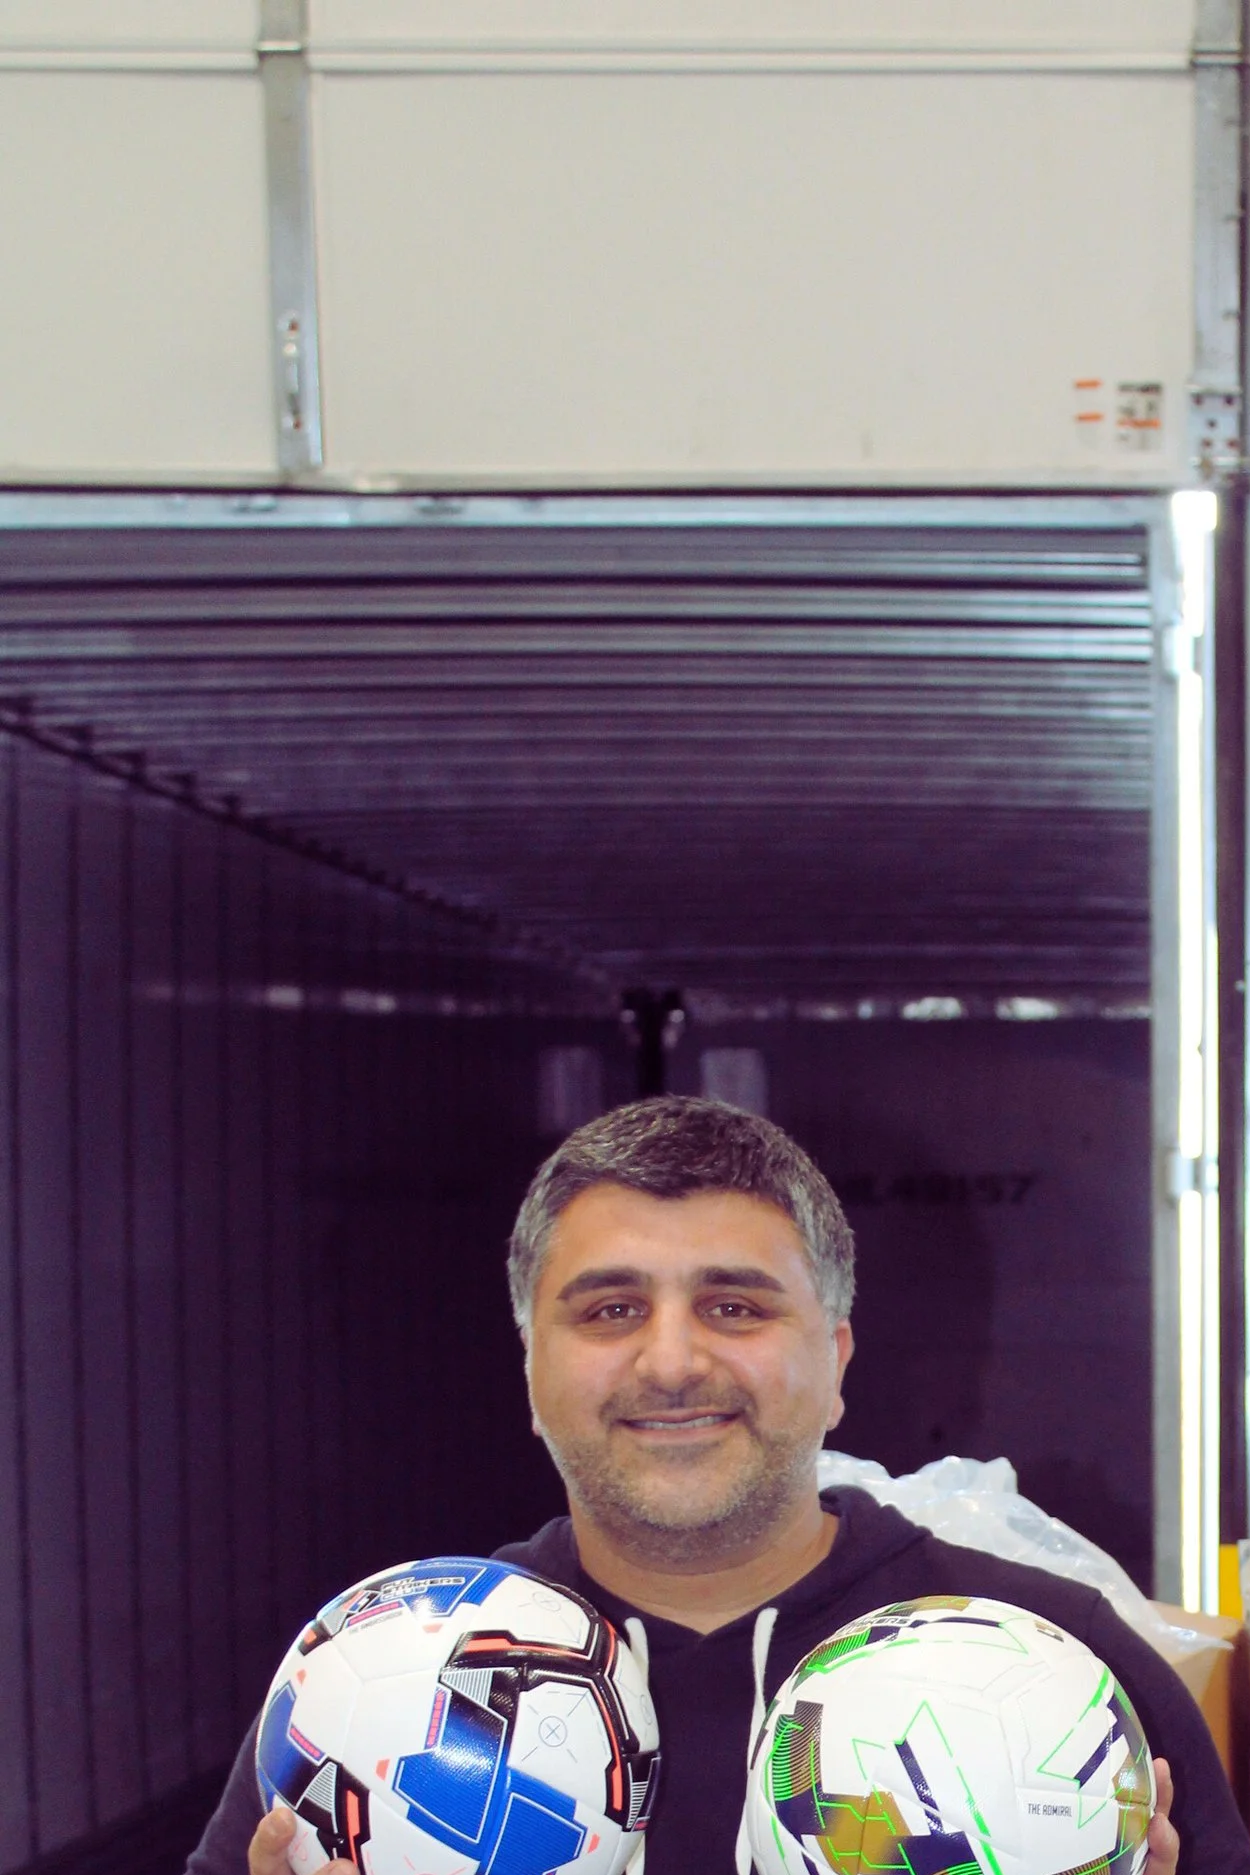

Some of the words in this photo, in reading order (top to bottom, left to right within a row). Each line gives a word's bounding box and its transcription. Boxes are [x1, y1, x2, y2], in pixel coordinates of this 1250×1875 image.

[383, 1578, 463, 1595] STRIKERS
[1027, 1802, 1041, 1815] THE
[1042, 1803, 1072, 1817] ADMIRAL
